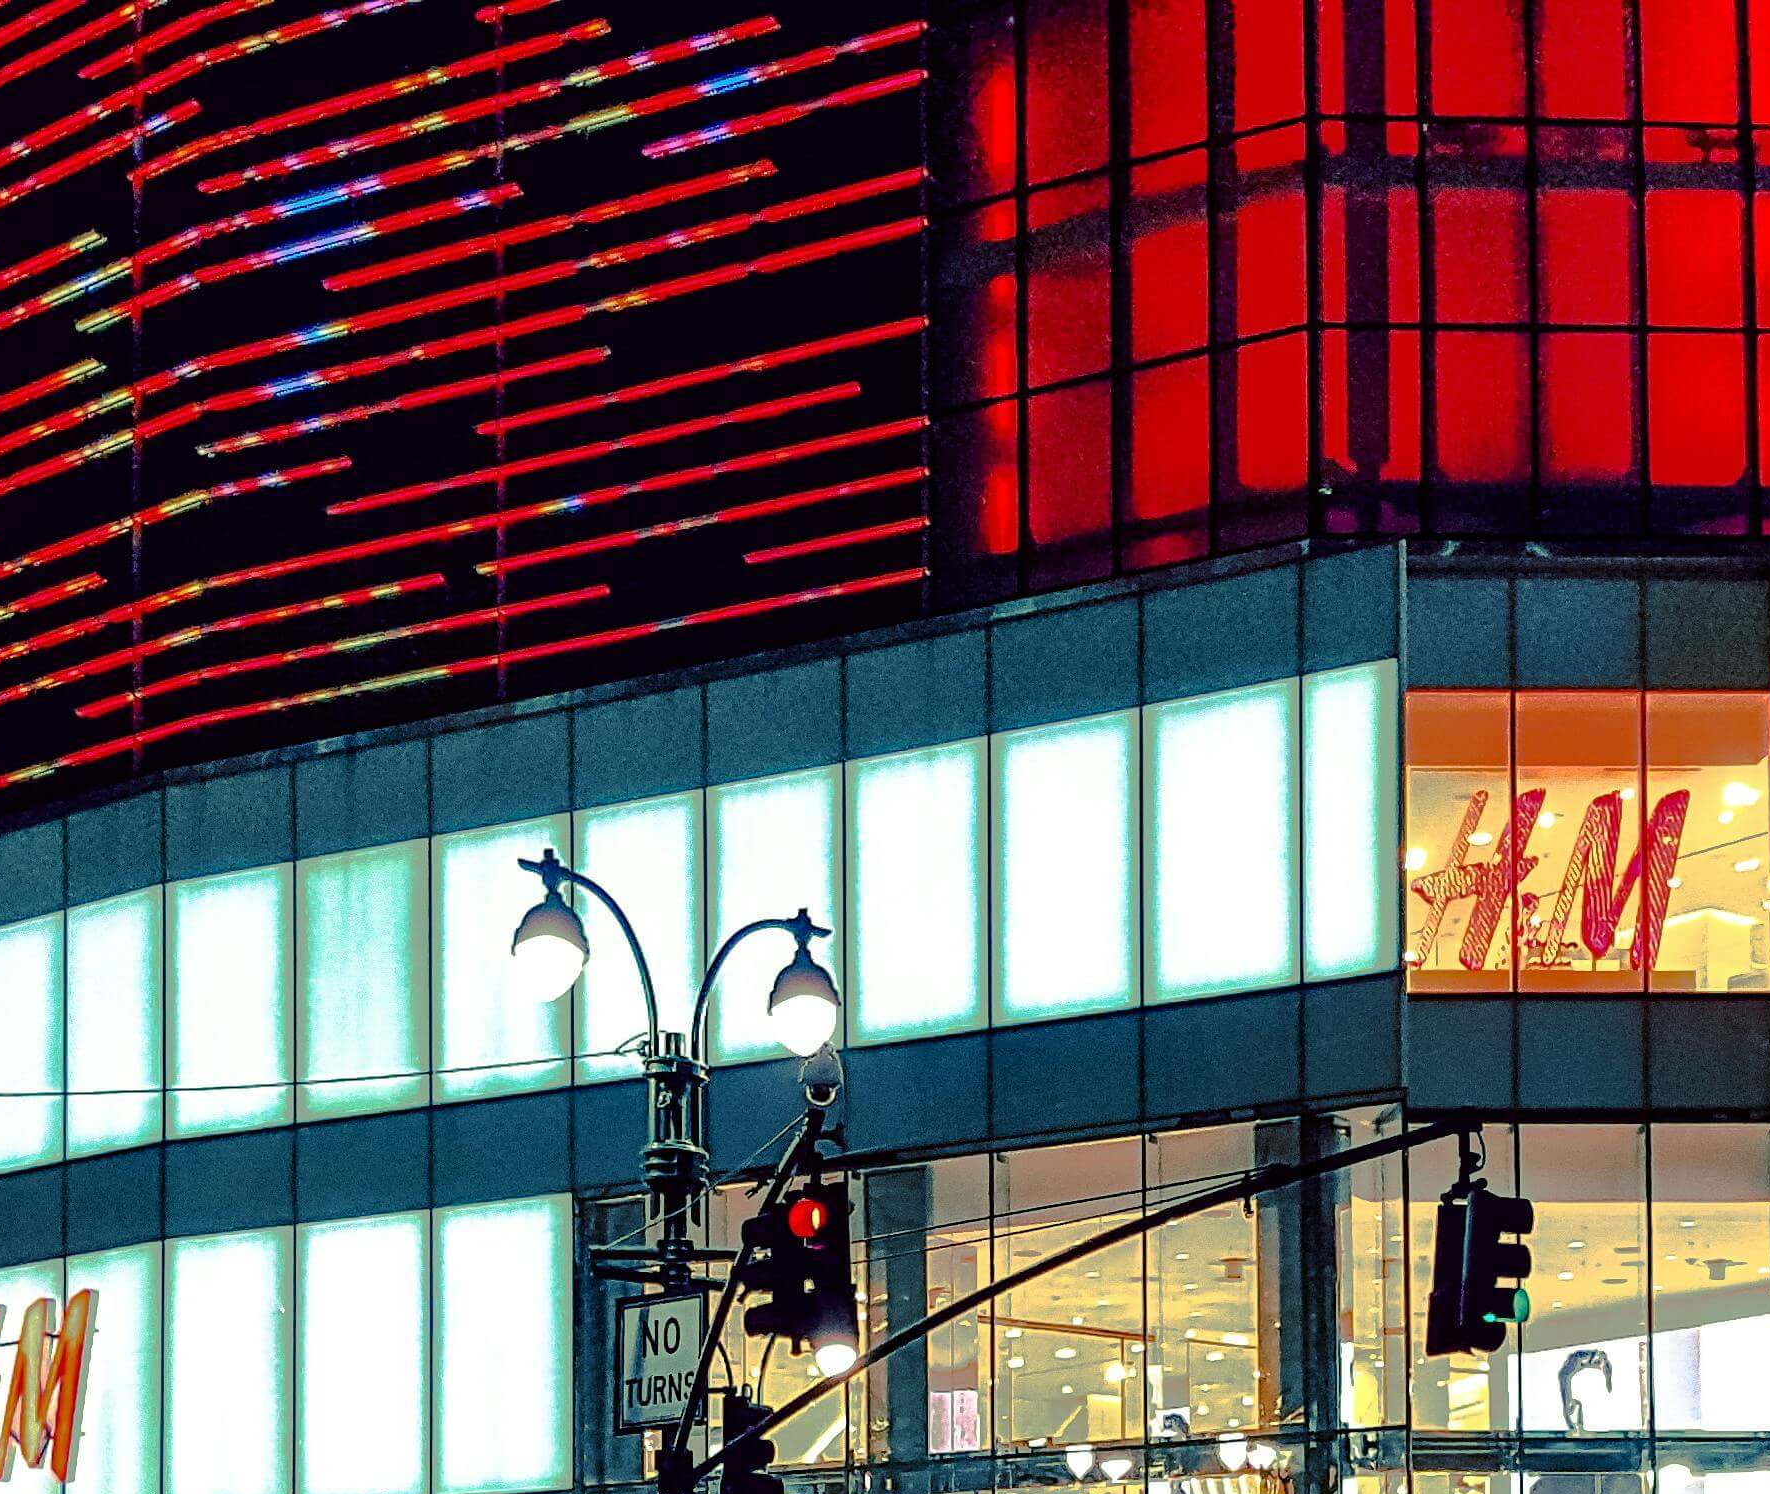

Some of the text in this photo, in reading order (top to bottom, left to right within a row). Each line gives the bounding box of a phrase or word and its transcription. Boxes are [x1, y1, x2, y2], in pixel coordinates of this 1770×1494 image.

[1411, 788, 1691, 971] H&M
[642, 1317, 681, 1358] NO
[625, 1370, 695, 1409] TURNS
